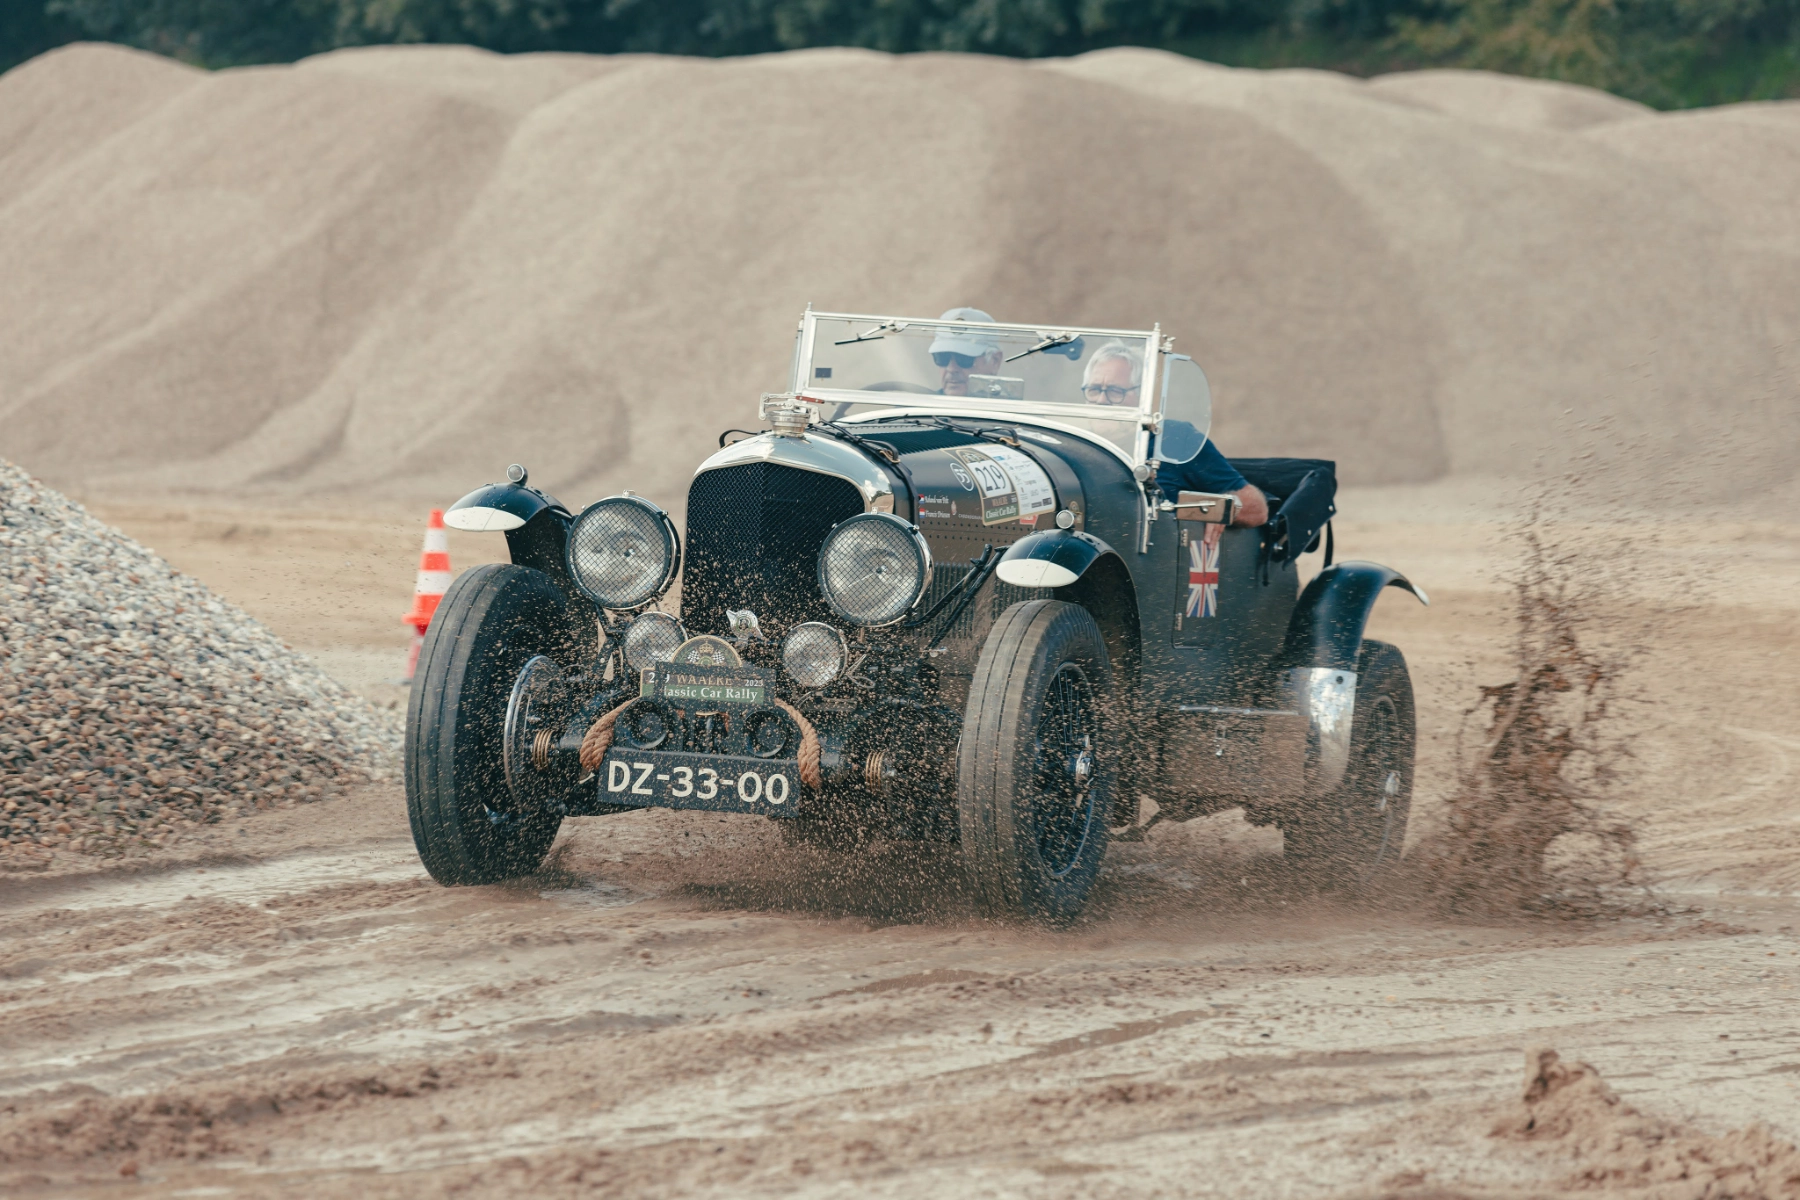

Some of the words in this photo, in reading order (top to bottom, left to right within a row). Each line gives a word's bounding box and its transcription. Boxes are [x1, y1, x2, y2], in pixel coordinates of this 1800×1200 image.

[975, 465, 1006, 491] 219
[648, 672, 670, 683] 29
[663, 685, 697, 697] lassic
[700, 687, 722, 698] Car
[726, 688, 758, 702] Rally
[607, 760, 789, 805] DZ-33-00
